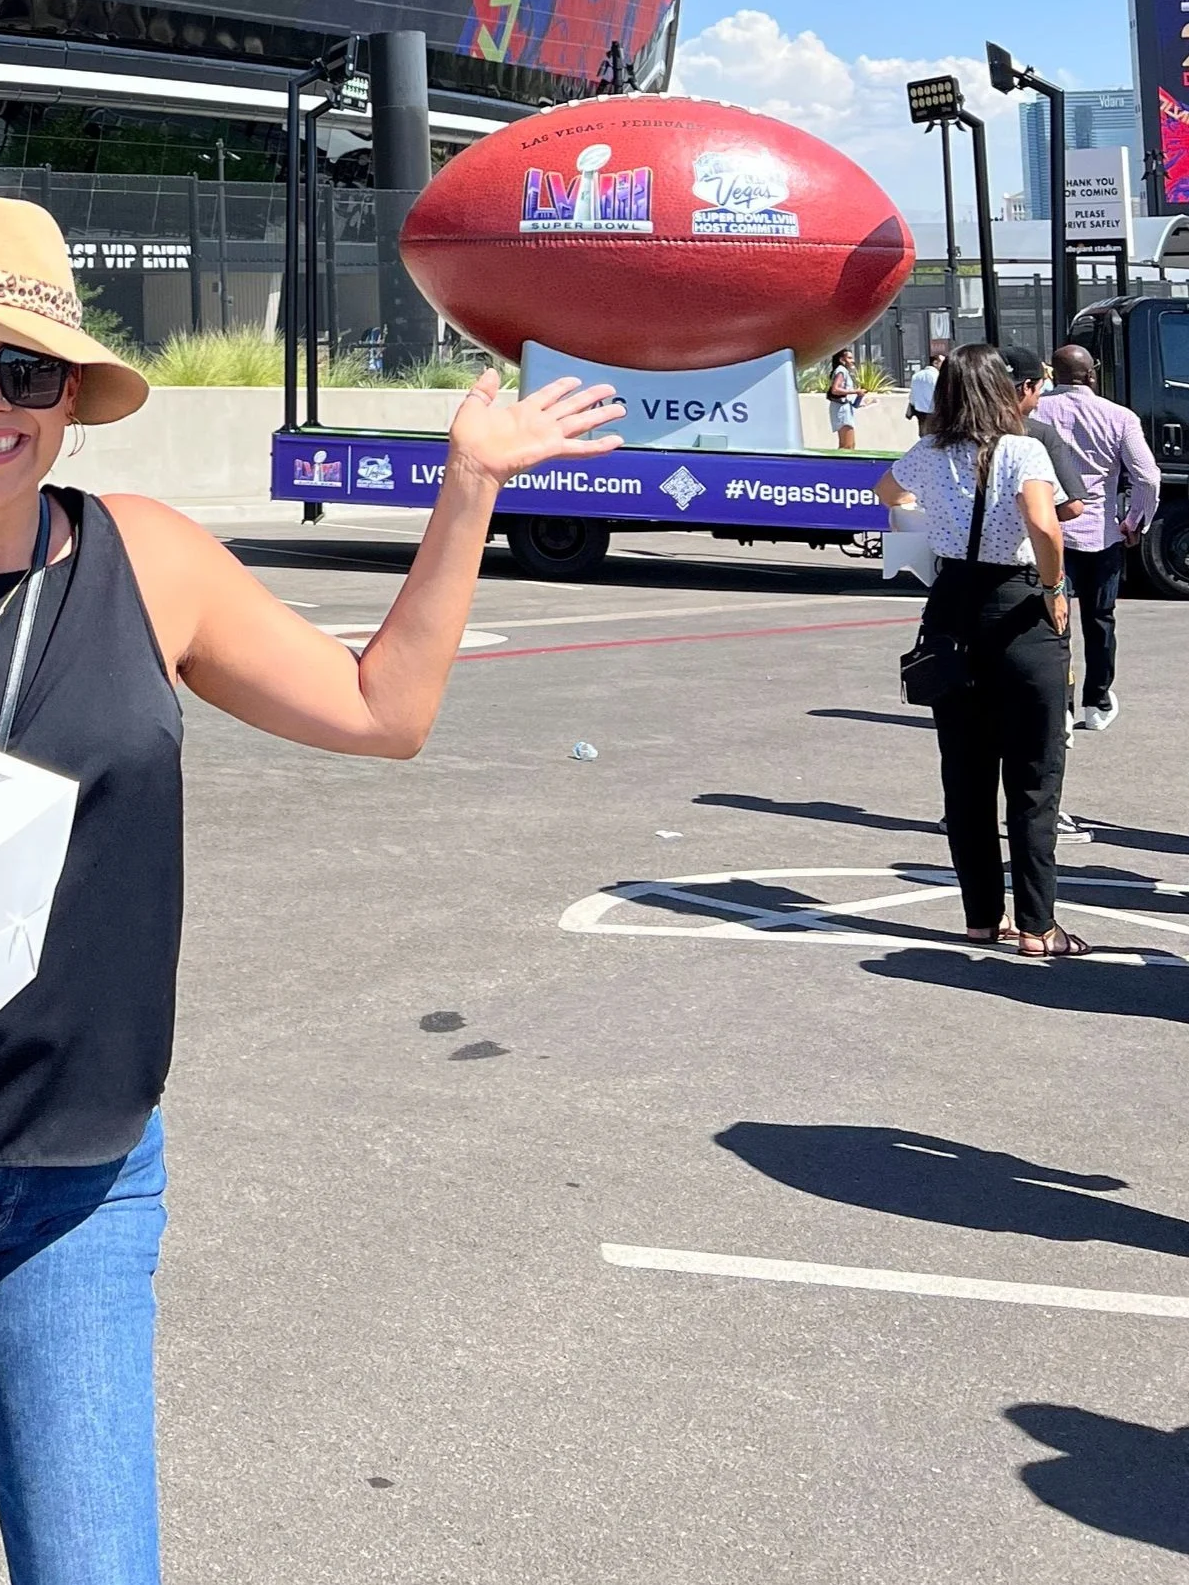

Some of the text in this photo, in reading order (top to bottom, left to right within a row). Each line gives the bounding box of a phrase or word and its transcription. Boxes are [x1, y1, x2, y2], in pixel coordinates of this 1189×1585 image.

[1099, 94, 1125, 109] Vdara
[521, 134, 549, 150] LAS
[556, 122, 604, 138] VEGAS
[1066, 177, 1115, 187] HANK YOU
[701, 174, 780, 210] Vegas
[1065, 187, 1118, 198] OR COMING
[694, 212, 796, 225] SUPER BOWL LVIII
[1074, 209, 1105, 219] PLEASE
[531, 221, 640, 231] SUPER BOWL
[694, 222, 798, 235] HOST COMMITTEE
[1065, 219, 1121, 229] RIVE SAFELY
[1094, 244, 1122, 253] stadium
[64, 243, 191, 269] AST VIP ENTR
[641, 398, 750, 424] VEGAS
